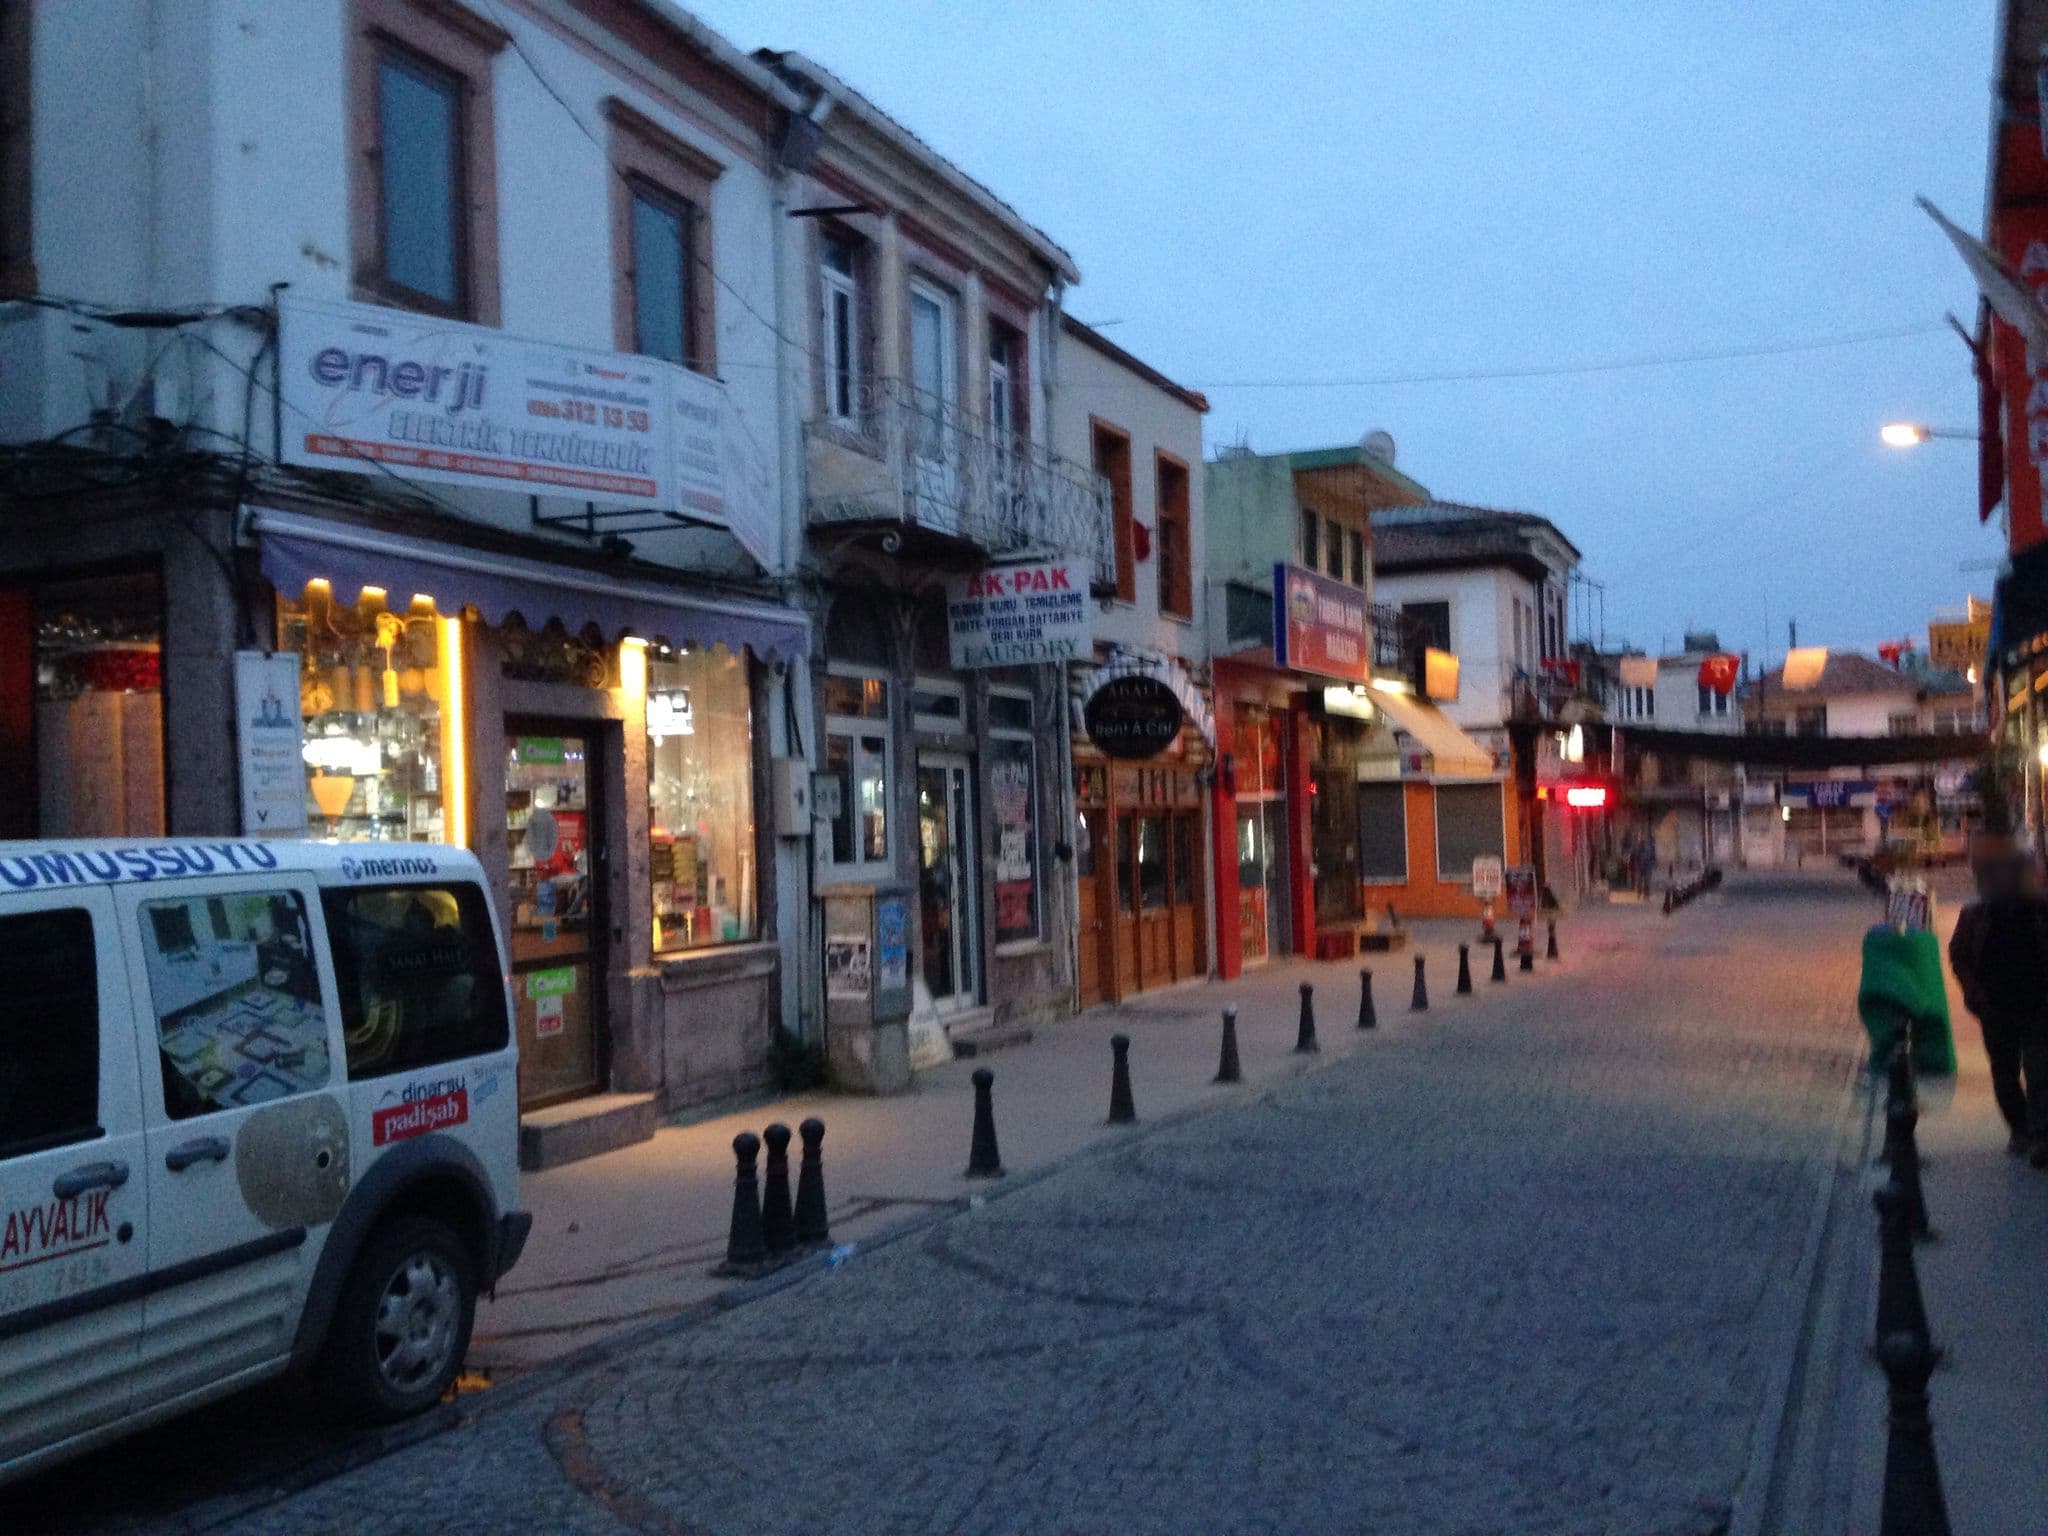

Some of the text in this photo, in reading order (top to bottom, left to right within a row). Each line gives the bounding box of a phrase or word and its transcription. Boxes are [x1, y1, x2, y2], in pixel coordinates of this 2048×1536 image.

[311, 347, 488, 415] enerji
[963, 635, 1079, 665] LAUNDRY
[362, 857, 438, 877] merinos
[1, 1186, 110, 1260] AYVALIK
